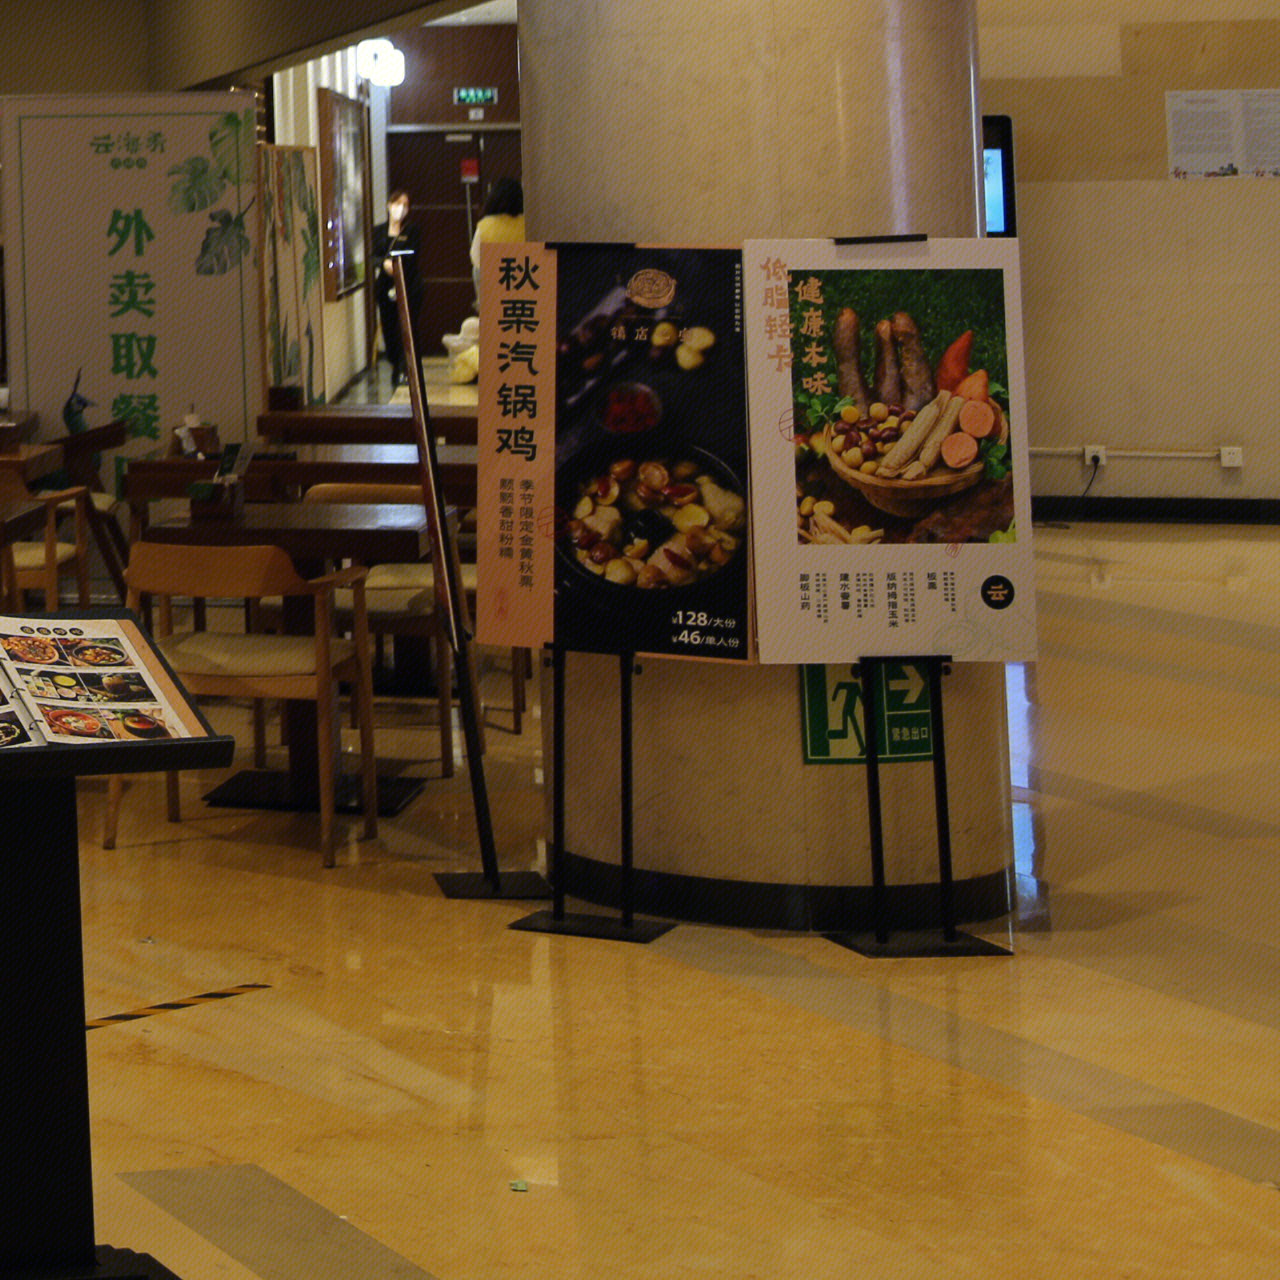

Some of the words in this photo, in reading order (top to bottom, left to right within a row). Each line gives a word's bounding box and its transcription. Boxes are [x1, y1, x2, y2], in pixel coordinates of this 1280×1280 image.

[106, 208, 161, 480] 外卖取餐
[495, 255, 540, 462] 秋栗汽锅鸡
[760, 257, 795, 372] 低脂轻卡
[794, 276, 833, 396] 健康本味
[986, 584, 1009, 601] 云
